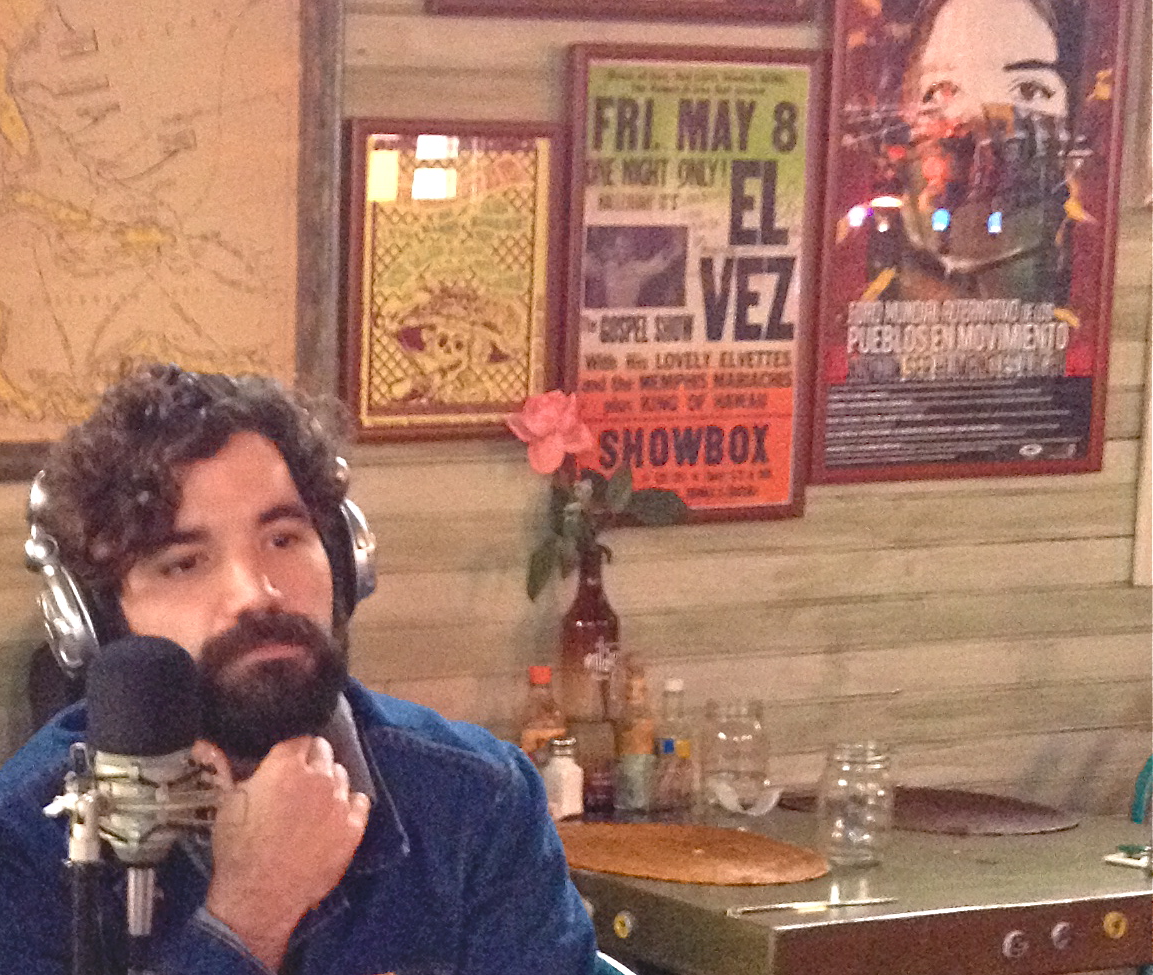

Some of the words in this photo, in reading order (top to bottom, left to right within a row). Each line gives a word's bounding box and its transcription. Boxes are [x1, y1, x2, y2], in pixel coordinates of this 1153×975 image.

[594, 98, 661, 151] FRI.
[676, 99, 756, 152] MAY
[772, 101, 797, 153] 8
[729, 160, 789, 245] EL
[699, 257, 796, 341] VEZ
[600, 315, 648, 343] GOSPEL
[654, 315, 694, 342] SHOW
[847, 323, 931, 354] PUEBLOS
[933, 324, 956, 351] EN
[957, 321, 1070, 351] MOVIMIENTO
[655, 351, 710, 370] LOVELY
[719, 350, 792, 369] ELVETTES
[598, 424, 769, 469] SHOWBOX
